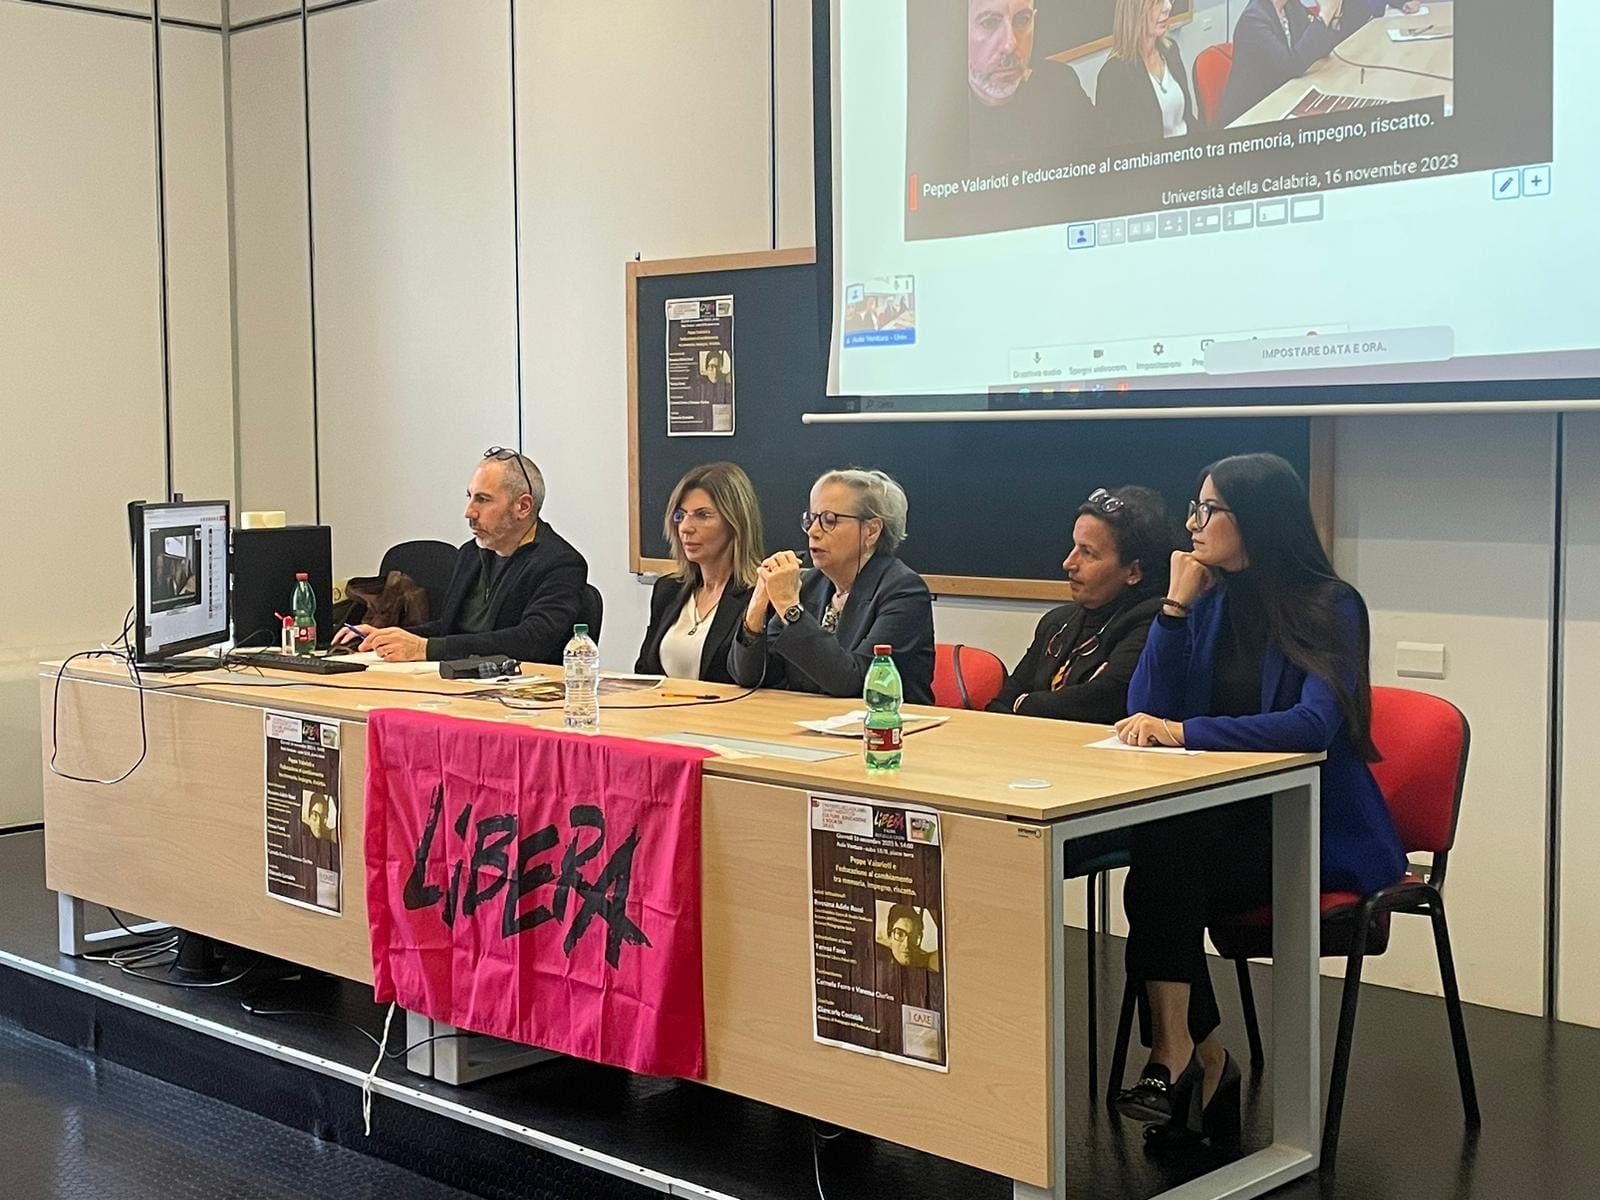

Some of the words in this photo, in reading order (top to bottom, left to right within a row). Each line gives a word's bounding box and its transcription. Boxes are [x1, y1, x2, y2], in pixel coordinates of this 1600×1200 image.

[923, 182, 959, 197] Peppe
[961, 176, 1009, 193] Valarioti
[1012, 175, 1019, 186] e
[1022, 161, 1096, 185] l'educazione
[1099, 158, 1111, 173] al
[1113, 145, 1203, 172] cambiamento
[1206, 140, 1225, 157] tra
[1228, 132, 1295, 155] memoria,
[1298, 123, 1367, 146] impegno,
[1370, 113, 1435, 134] riscatto.
[1162, 182, 1224, 205] Università
[1227, 178, 1258, 197] della
[1262, 172, 1321, 193] Calabria,
[1325, 169, 1342, 185] 16
[1345, 160, 1417, 181] novembre
[1420, 153, 1459, 172] 2023
[1262, 347, 1321, 359] IMPOSTARE
[1322, 344, 1351, 356] DATA
[1353, 344, 1360, 354] E
[1361, 342, 1387, 353] ORA.
